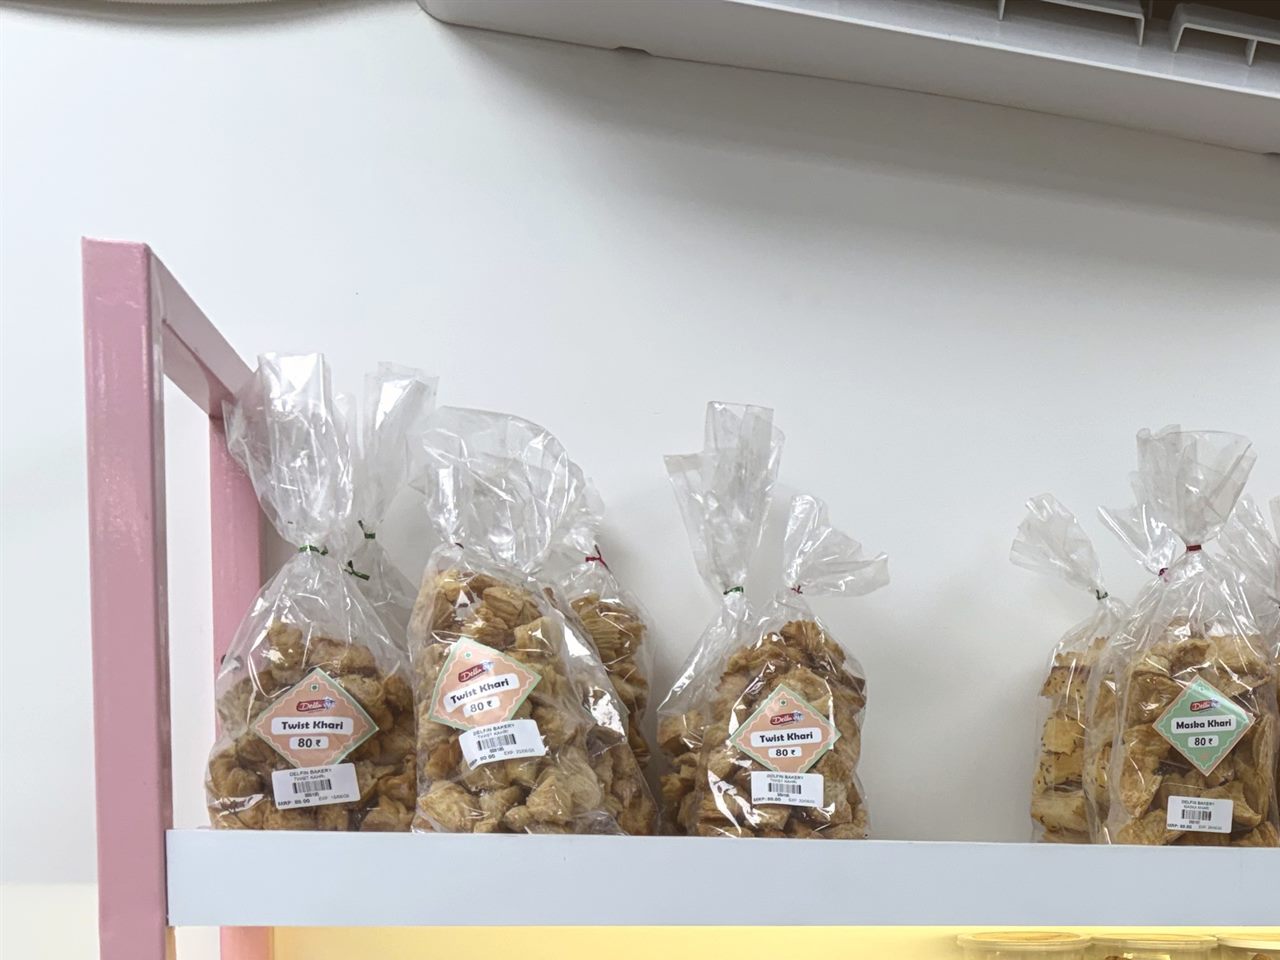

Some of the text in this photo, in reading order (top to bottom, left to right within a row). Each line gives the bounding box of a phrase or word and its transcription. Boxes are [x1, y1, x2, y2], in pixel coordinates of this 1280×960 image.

[450, 679, 509, 704] Twist Khari
[470, 703, 484, 713] 80
[282, 720, 343, 730] Twist Khari
[1176, 719, 1232, 729] Maska Khari
[760, 732, 813, 743] Twist Khari
[1194, 737, 1206, 746] 80
[298, 738, 312, 748] 80
